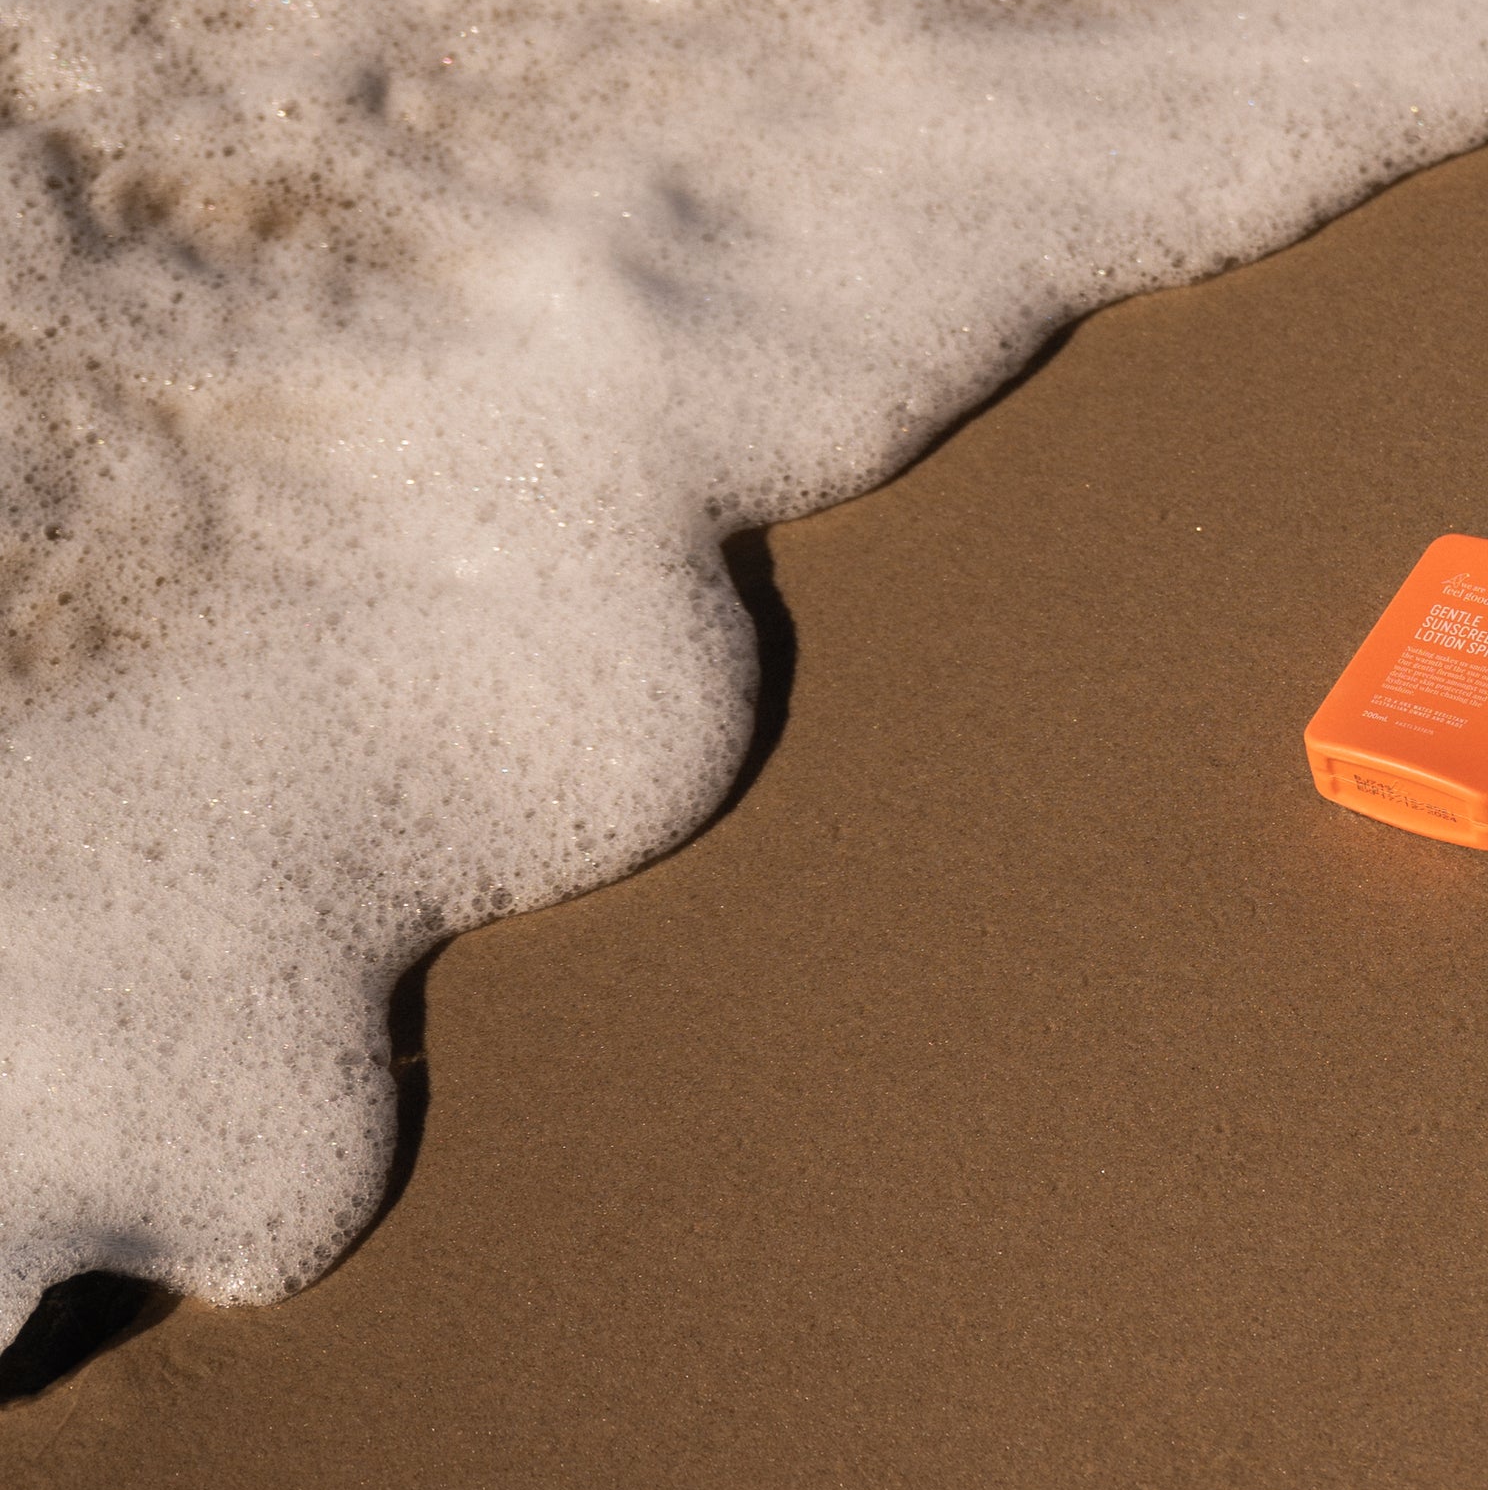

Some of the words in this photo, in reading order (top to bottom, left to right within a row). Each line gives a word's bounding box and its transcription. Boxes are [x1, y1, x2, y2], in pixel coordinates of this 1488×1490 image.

[1442, 585, 1465, 597] feel
[1430, 604, 1483, 627] GENTLE
[1414, 628, 1466, 650] LOTION
[1405, 646, 1435, 659] Nothing
[1435, 655, 1459, 665] makes
[1415, 656, 1443, 668] warmth
[1398, 658, 1412, 666] Our
[1412, 663, 1436, 673] gentle
[1436, 669, 1466, 681] formula
[1413, 670, 1445, 682] precious
[1385, 676, 1419, 690] hydrated
[1419, 686, 1439, 695] when
[1440, 691, 1469, 704] chasing
[1469, 700, 1482, 708] the
[1419, 679, 1435, 687] skin
[1435, 683, 1473, 697] protected
[1472, 694, 1488, 702] and
[1362, 710, 1388, 722] 200mL
[1371, 699, 1407, 712] AUSTRALIAN
[1409, 709, 1430, 718] OWNED
[1446, 720, 1463, 728] MADE
[1413, 705, 1432, 713] WATER
[1434, 711, 1468, 724] RESISTANT
